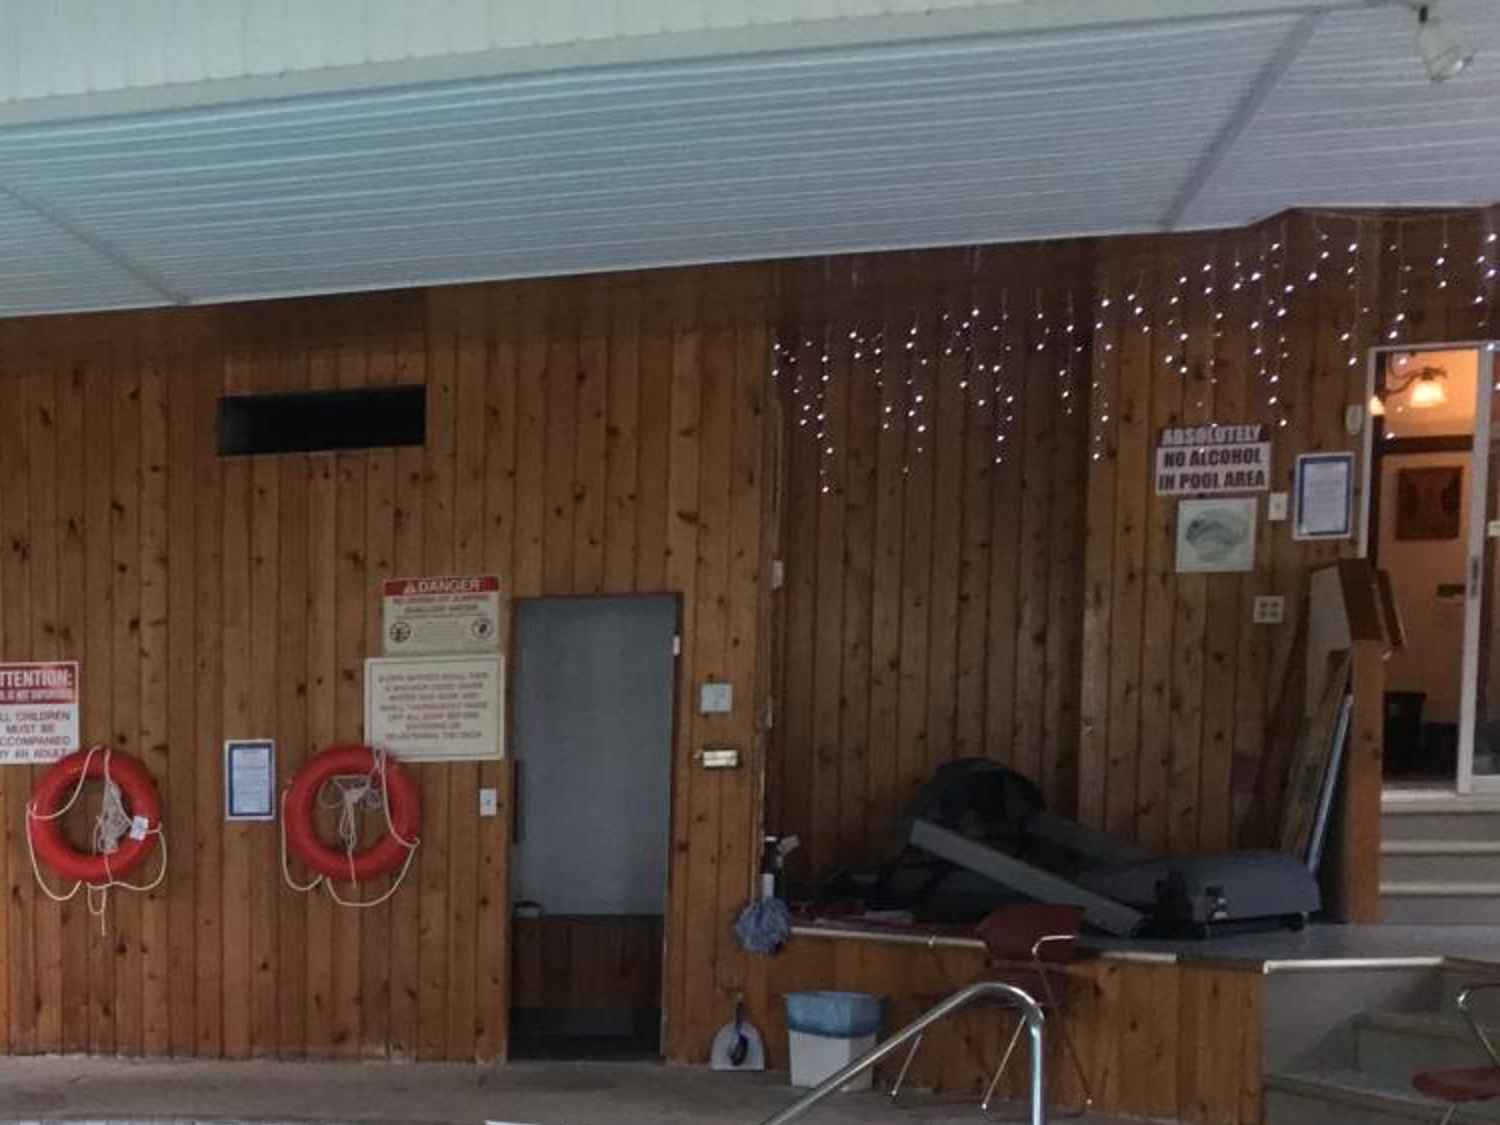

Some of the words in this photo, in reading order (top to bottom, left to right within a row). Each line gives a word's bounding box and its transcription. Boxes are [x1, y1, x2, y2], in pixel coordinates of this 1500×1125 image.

[1161, 425, 1261, 445] ABSOLUTELY
[1164, 451, 1186, 467] NO
[1189, 448, 1260, 467] ALCOHOL
[1159, 474, 1176, 490] IN
[1179, 472, 1219, 489] POOL
[1223, 469, 1265, 487] AREA
[418, 579, 480, 593] DANGER
[15, 710, 71, 721] CHILDREN
[6, 724, 36, 734] MUST
[41, 723, 54, 733] BE
